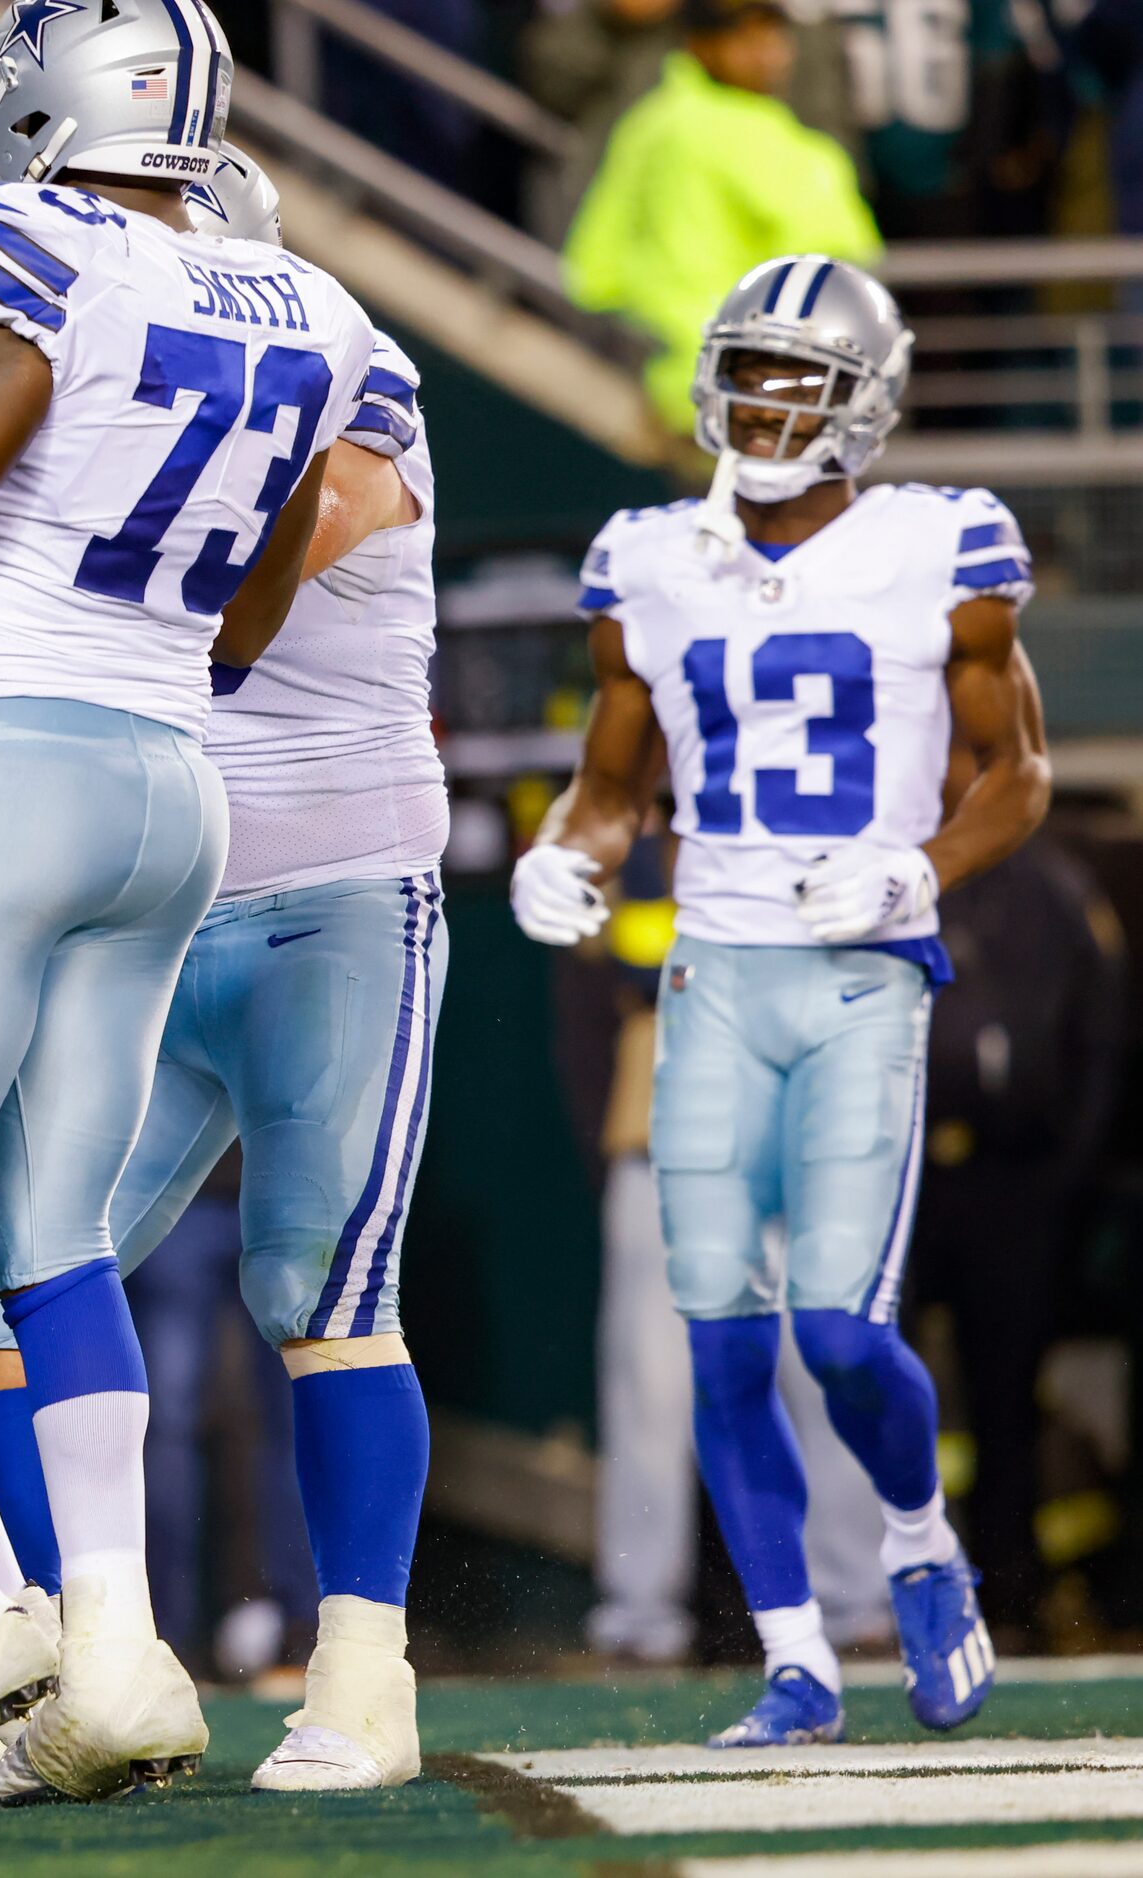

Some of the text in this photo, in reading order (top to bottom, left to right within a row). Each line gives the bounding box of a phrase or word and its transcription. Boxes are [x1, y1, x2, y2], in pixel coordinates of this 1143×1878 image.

[141, 152, 210, 174] COWBOYS
[178, 256, 310, 332] SMITH
[74, 323, 333, 615] 73
[683, 632, 876, 836] 13
